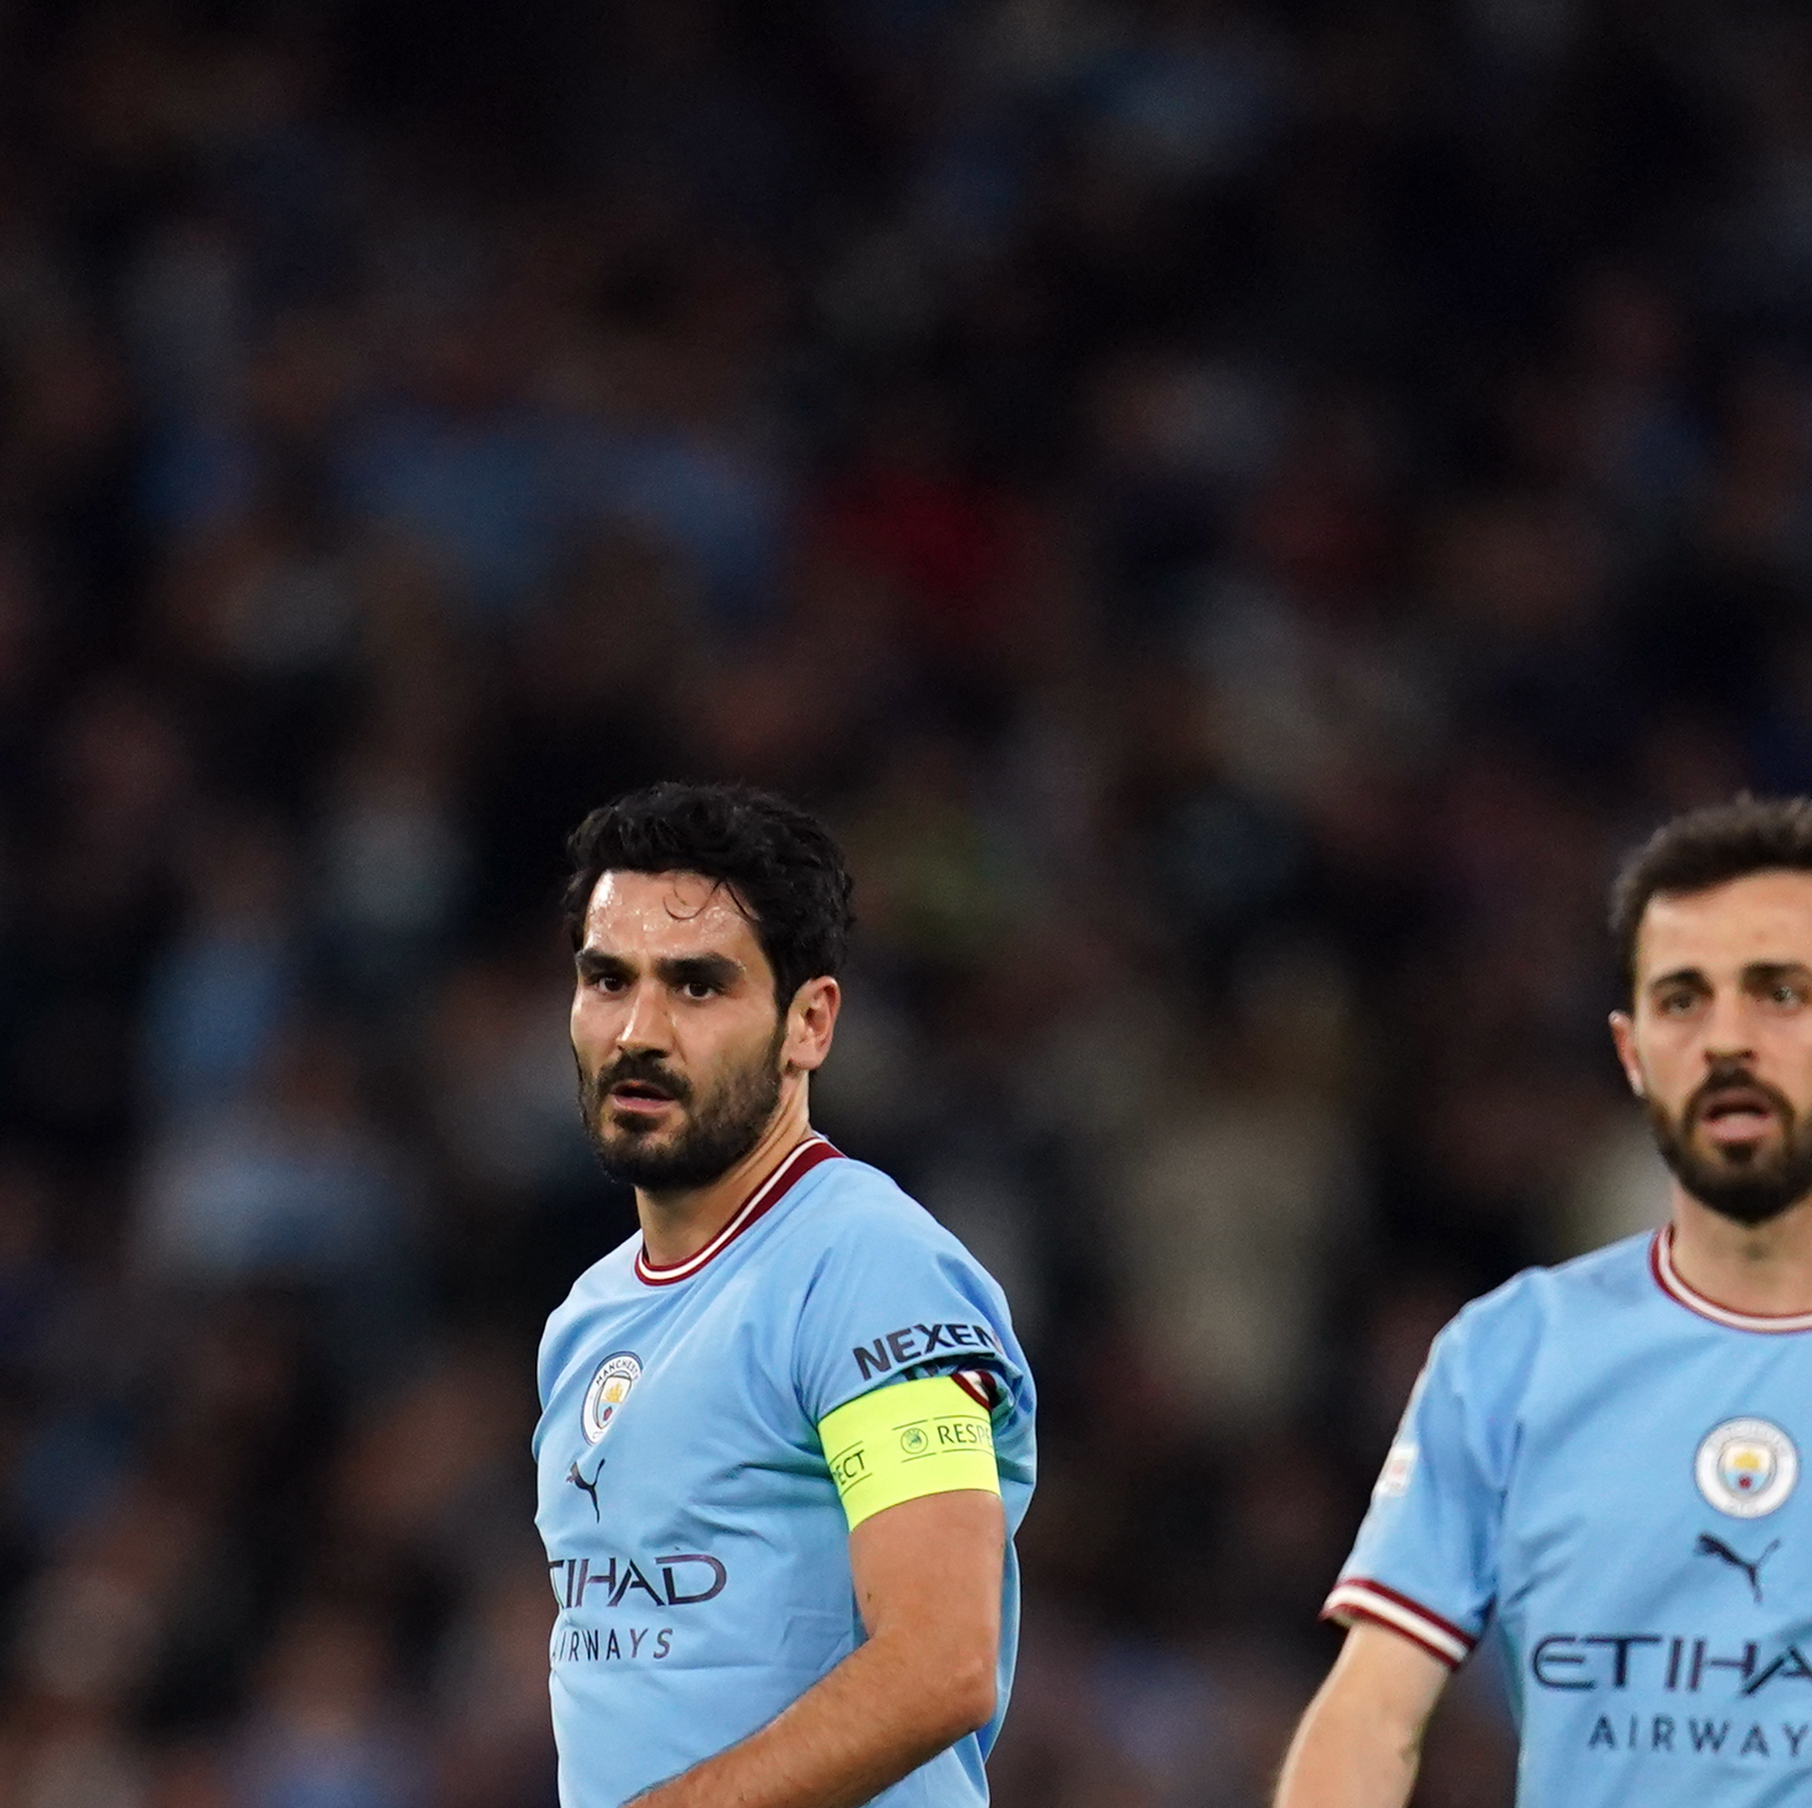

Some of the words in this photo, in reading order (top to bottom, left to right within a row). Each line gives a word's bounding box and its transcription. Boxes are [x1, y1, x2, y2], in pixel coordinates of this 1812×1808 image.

[853, 1324, 1004, 1382] NEXEN
[548, 1553, 727, 1609] TIHAD
[552, 1627, 674, 1662] IRWAYS
